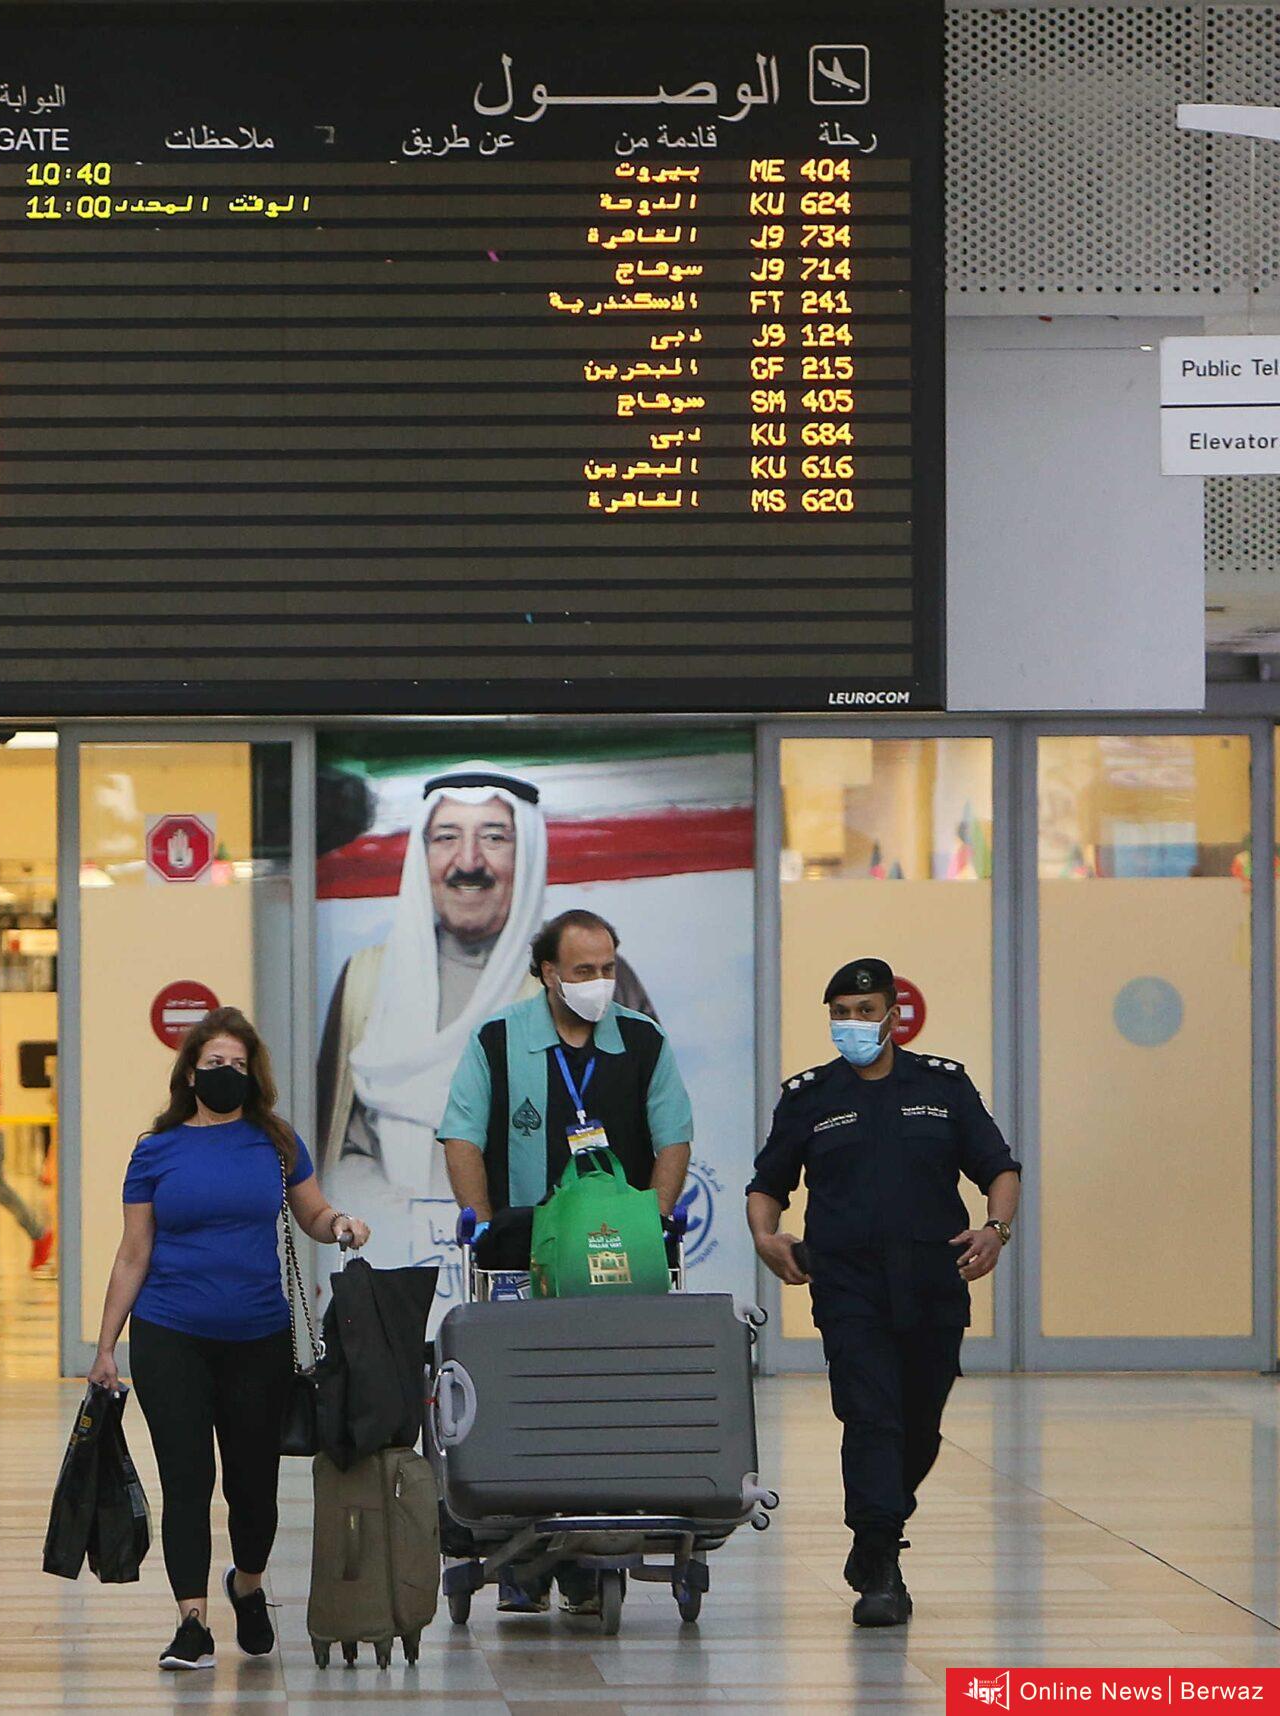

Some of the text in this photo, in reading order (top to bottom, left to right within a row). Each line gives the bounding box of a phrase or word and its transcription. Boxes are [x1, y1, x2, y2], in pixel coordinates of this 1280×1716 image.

[165, 124, 275, 150] ملاحظات
[402, 123, 515, 157] عن طريق
[614, 124, 718, 156] قادمة من
[818, 121, 878, 154] رحلة
[26, 162, 111, 186] 10:40
[615, 162, 700, 183] بيروت
[749, 158, 851, 183] ME 404
[26, 195, 112, 219] 11:00
[228, 195, 310, 218] الوقت
[599, 192, 697, 217] الدوحة
[749, 191, 852, 216] KU 624
[587, 225, 697, 250] القاهرة
[750, 224, 852, 250] J9 734
[615, 260, 703, 286] سوهاج
[750, 257, 852, 282] J9 714
[548, 291, 698, 316] الاسكندرية
[749, 290, 853, 314] FT 241
[752, 323, 854, 348] J9 124
[583, 357, 698, 382] البحرين
[750, 356, 854, 380] GF 215
[1182, 359, 1242, 377] Public
[617, 391, 706, 417] سوهاج
[750, 388, 854, 414] SM 405
[750, 422, 854, 447] KU 684
[583, 456, 699, 481] البحرين
[750, 455, 854, 479] KU 616
[588, 489, 699, 513] القاهرة
[751, 488, 854, 513] MS 620
[828, 691, 910, 705] LEUROCOM
